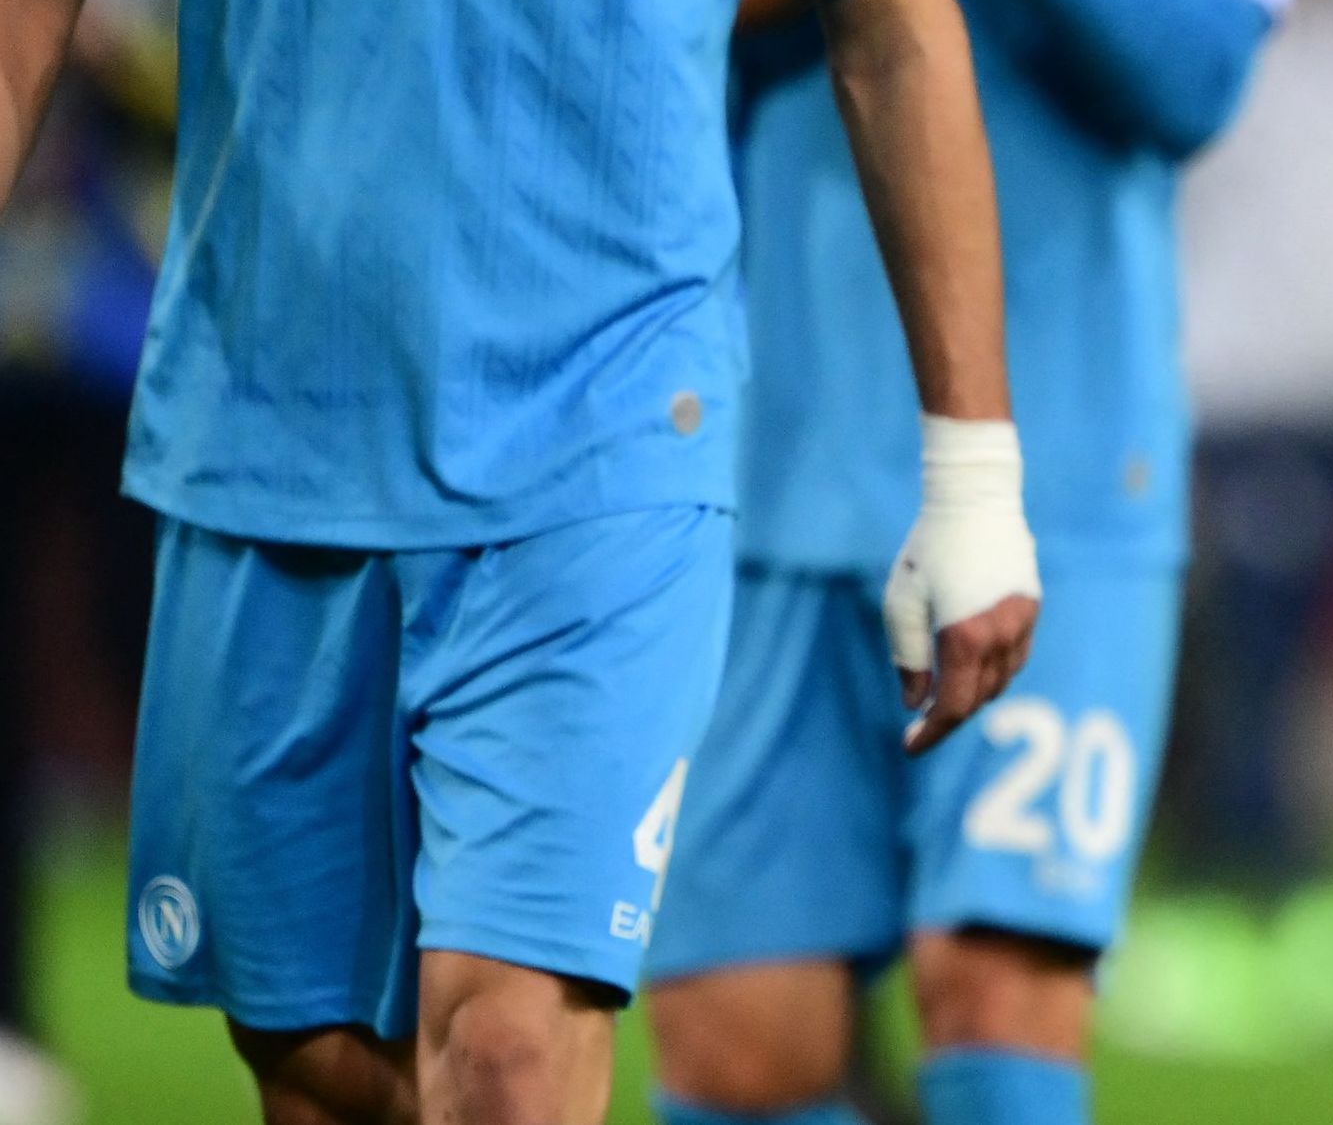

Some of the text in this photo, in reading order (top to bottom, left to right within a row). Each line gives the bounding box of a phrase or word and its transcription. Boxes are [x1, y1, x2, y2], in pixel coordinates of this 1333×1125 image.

[632, 757, 689, 912] 4
[964, 696, 1134, 860] 20
[609, 900, 653, 950] EA
